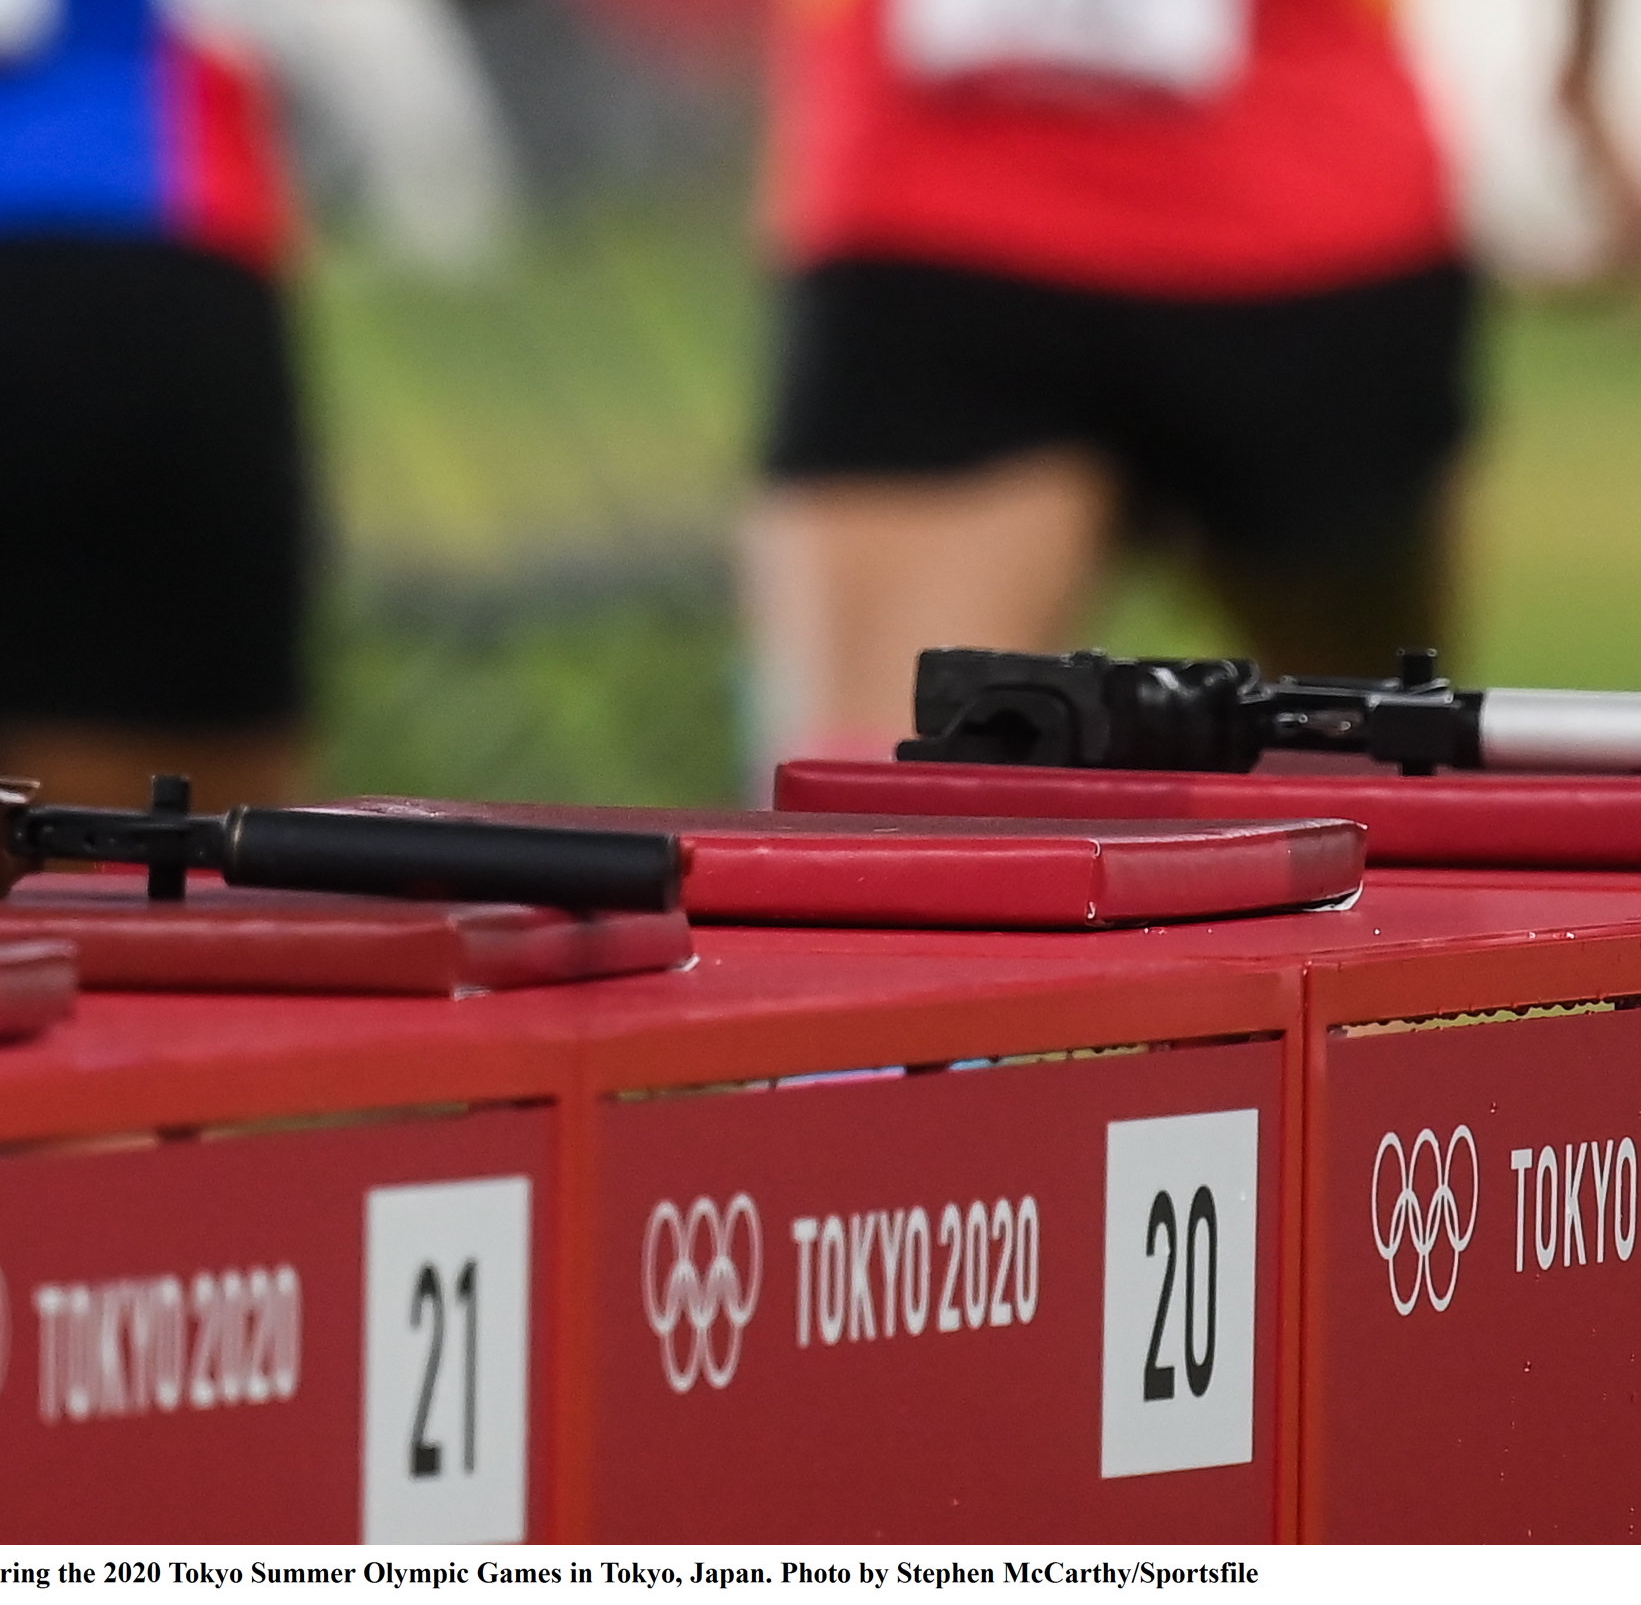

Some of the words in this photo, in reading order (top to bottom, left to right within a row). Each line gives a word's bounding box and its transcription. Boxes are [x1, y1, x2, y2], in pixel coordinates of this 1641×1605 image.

[791, 1206, 931, 1347] TOKYO
[937, 1195, 1040, 1333] 2020
[1511, 1136, 1637, 1272] TOKYO
[190, 1264, 303, 1408] 2020
[408, 1257, 479, 1477] 21
[1143, 1184, 1217, 1402] 20
